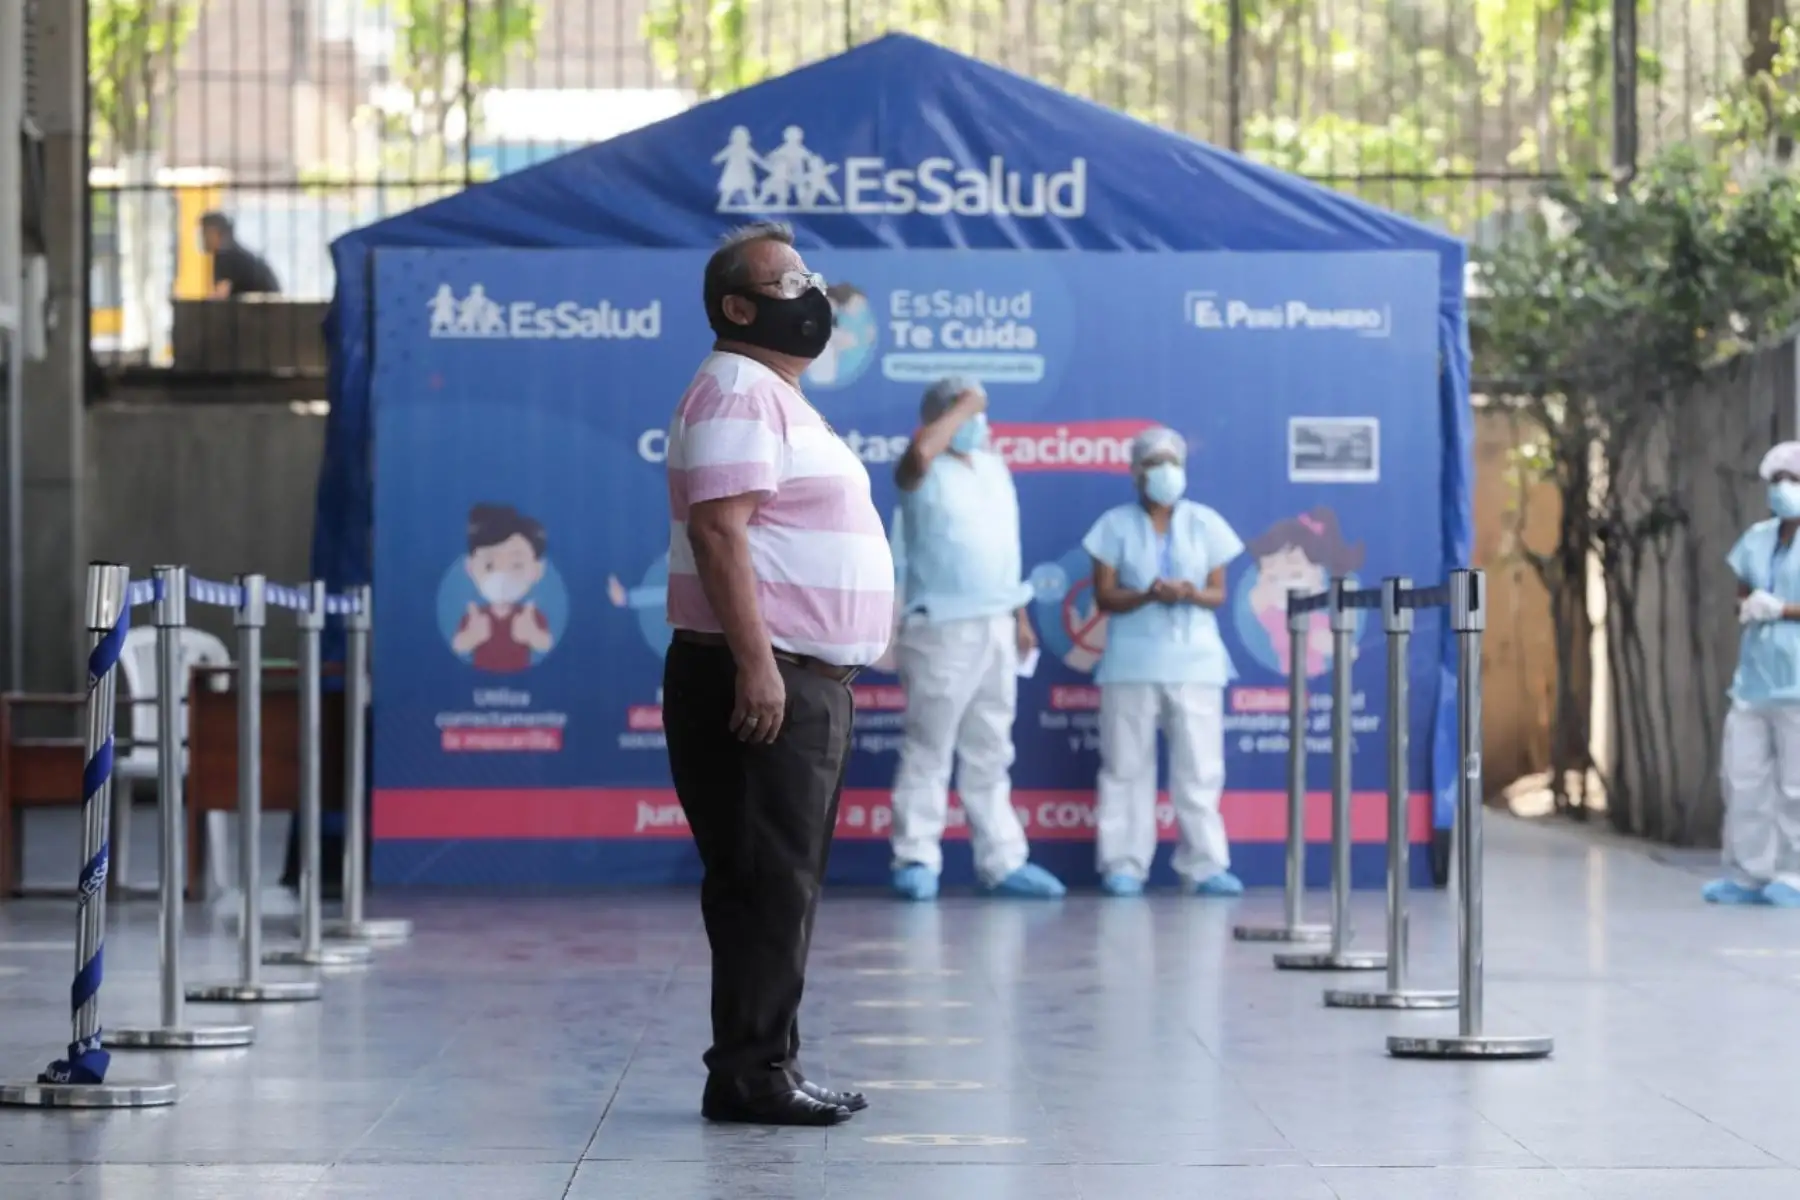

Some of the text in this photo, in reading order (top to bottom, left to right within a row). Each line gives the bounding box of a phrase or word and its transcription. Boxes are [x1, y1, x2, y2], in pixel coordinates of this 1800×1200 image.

[844, 155, 1087, 218] EsSalud
[509, 299, 662, 339] EsSalud
[890, 290, 1032, 319] EsSalud
[890, 321, 1037, 350] Te Cuida
